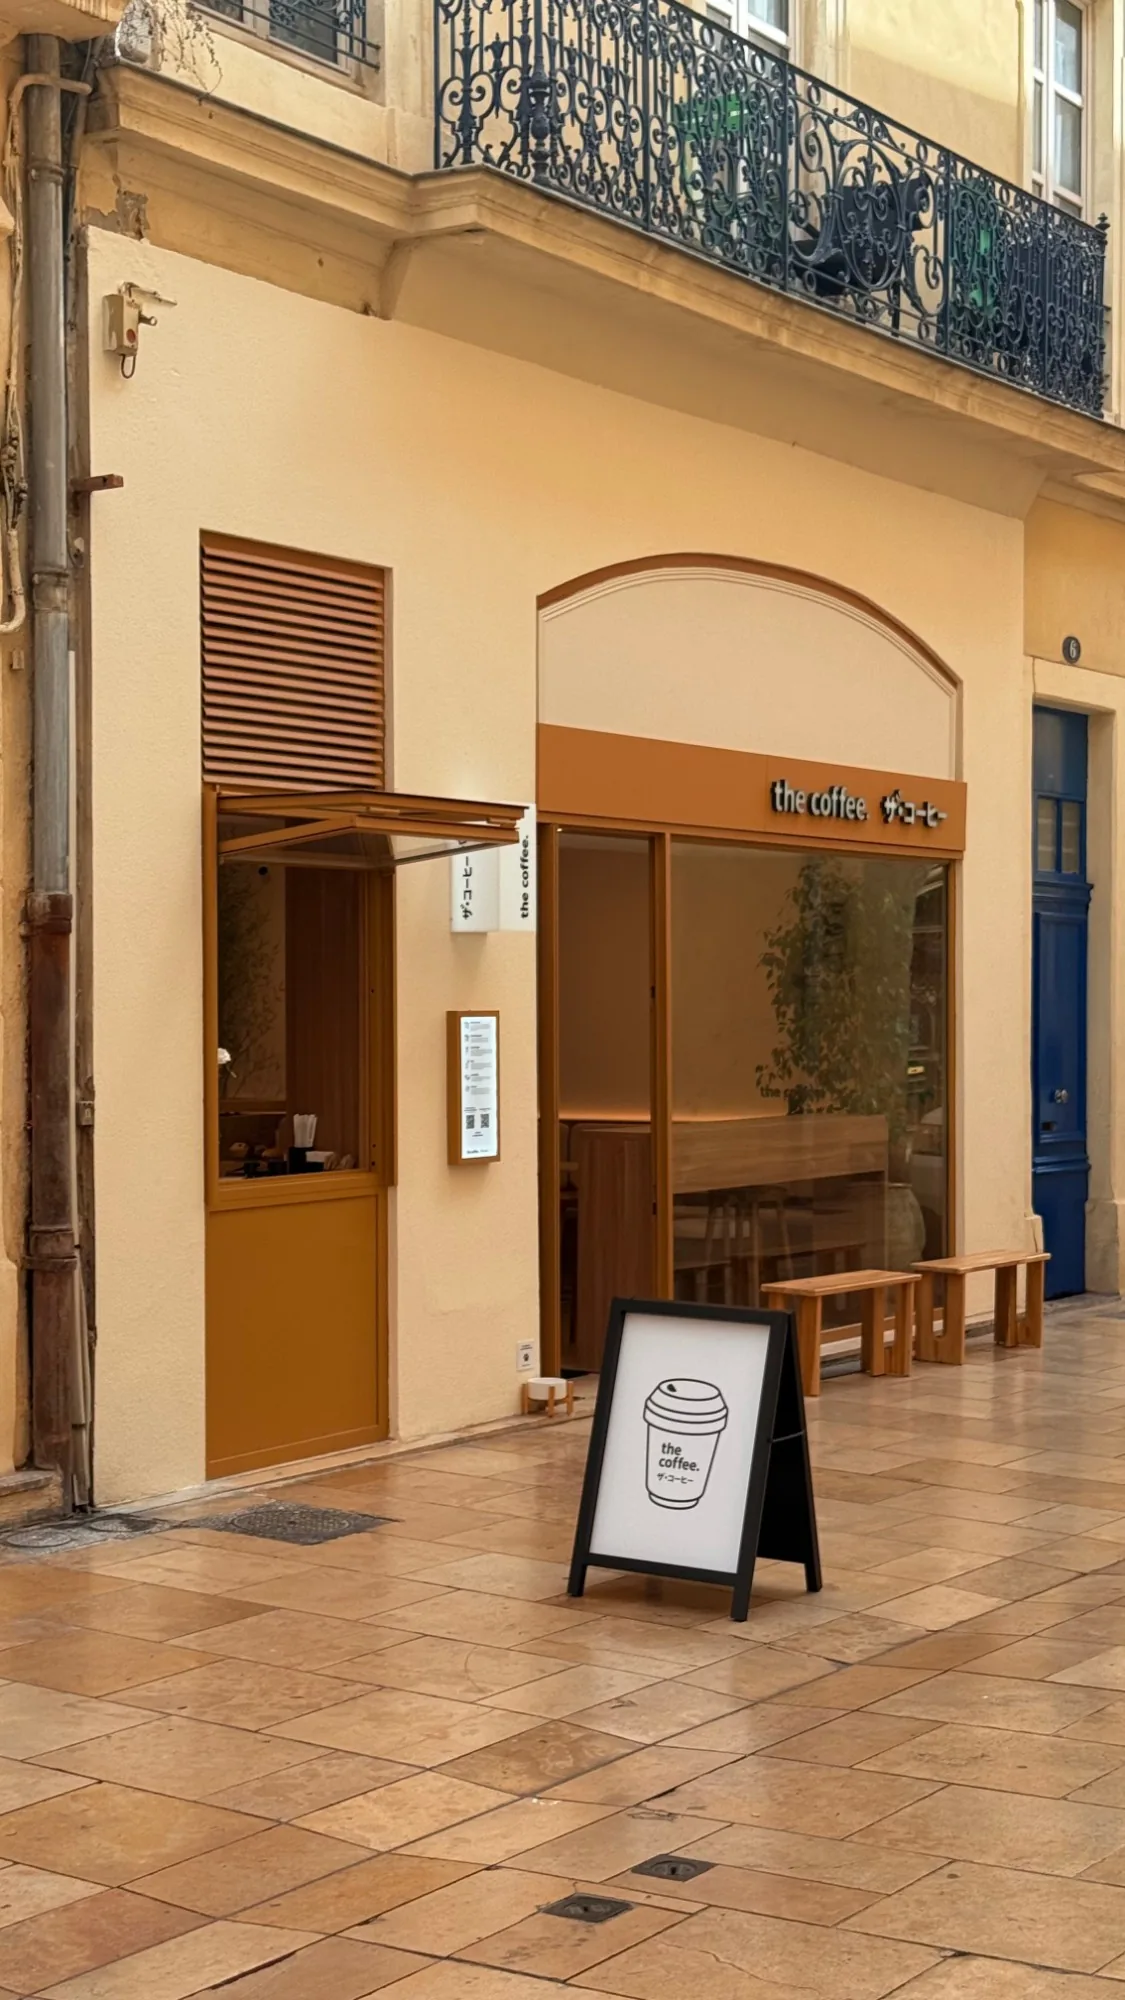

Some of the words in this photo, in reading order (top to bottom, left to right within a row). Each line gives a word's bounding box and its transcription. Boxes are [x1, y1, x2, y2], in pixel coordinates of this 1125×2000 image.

[1070, 639, 1077, 659] 6
[772, 779, 806, 814] the
[808, 785, 870, 821] coffee.
[520, 835, 529, 888] coffee.
[520, 892, 529, 919] the
[661, 1442, 682, 1456] the
[658, 1456, 700, 1472] coffee.
